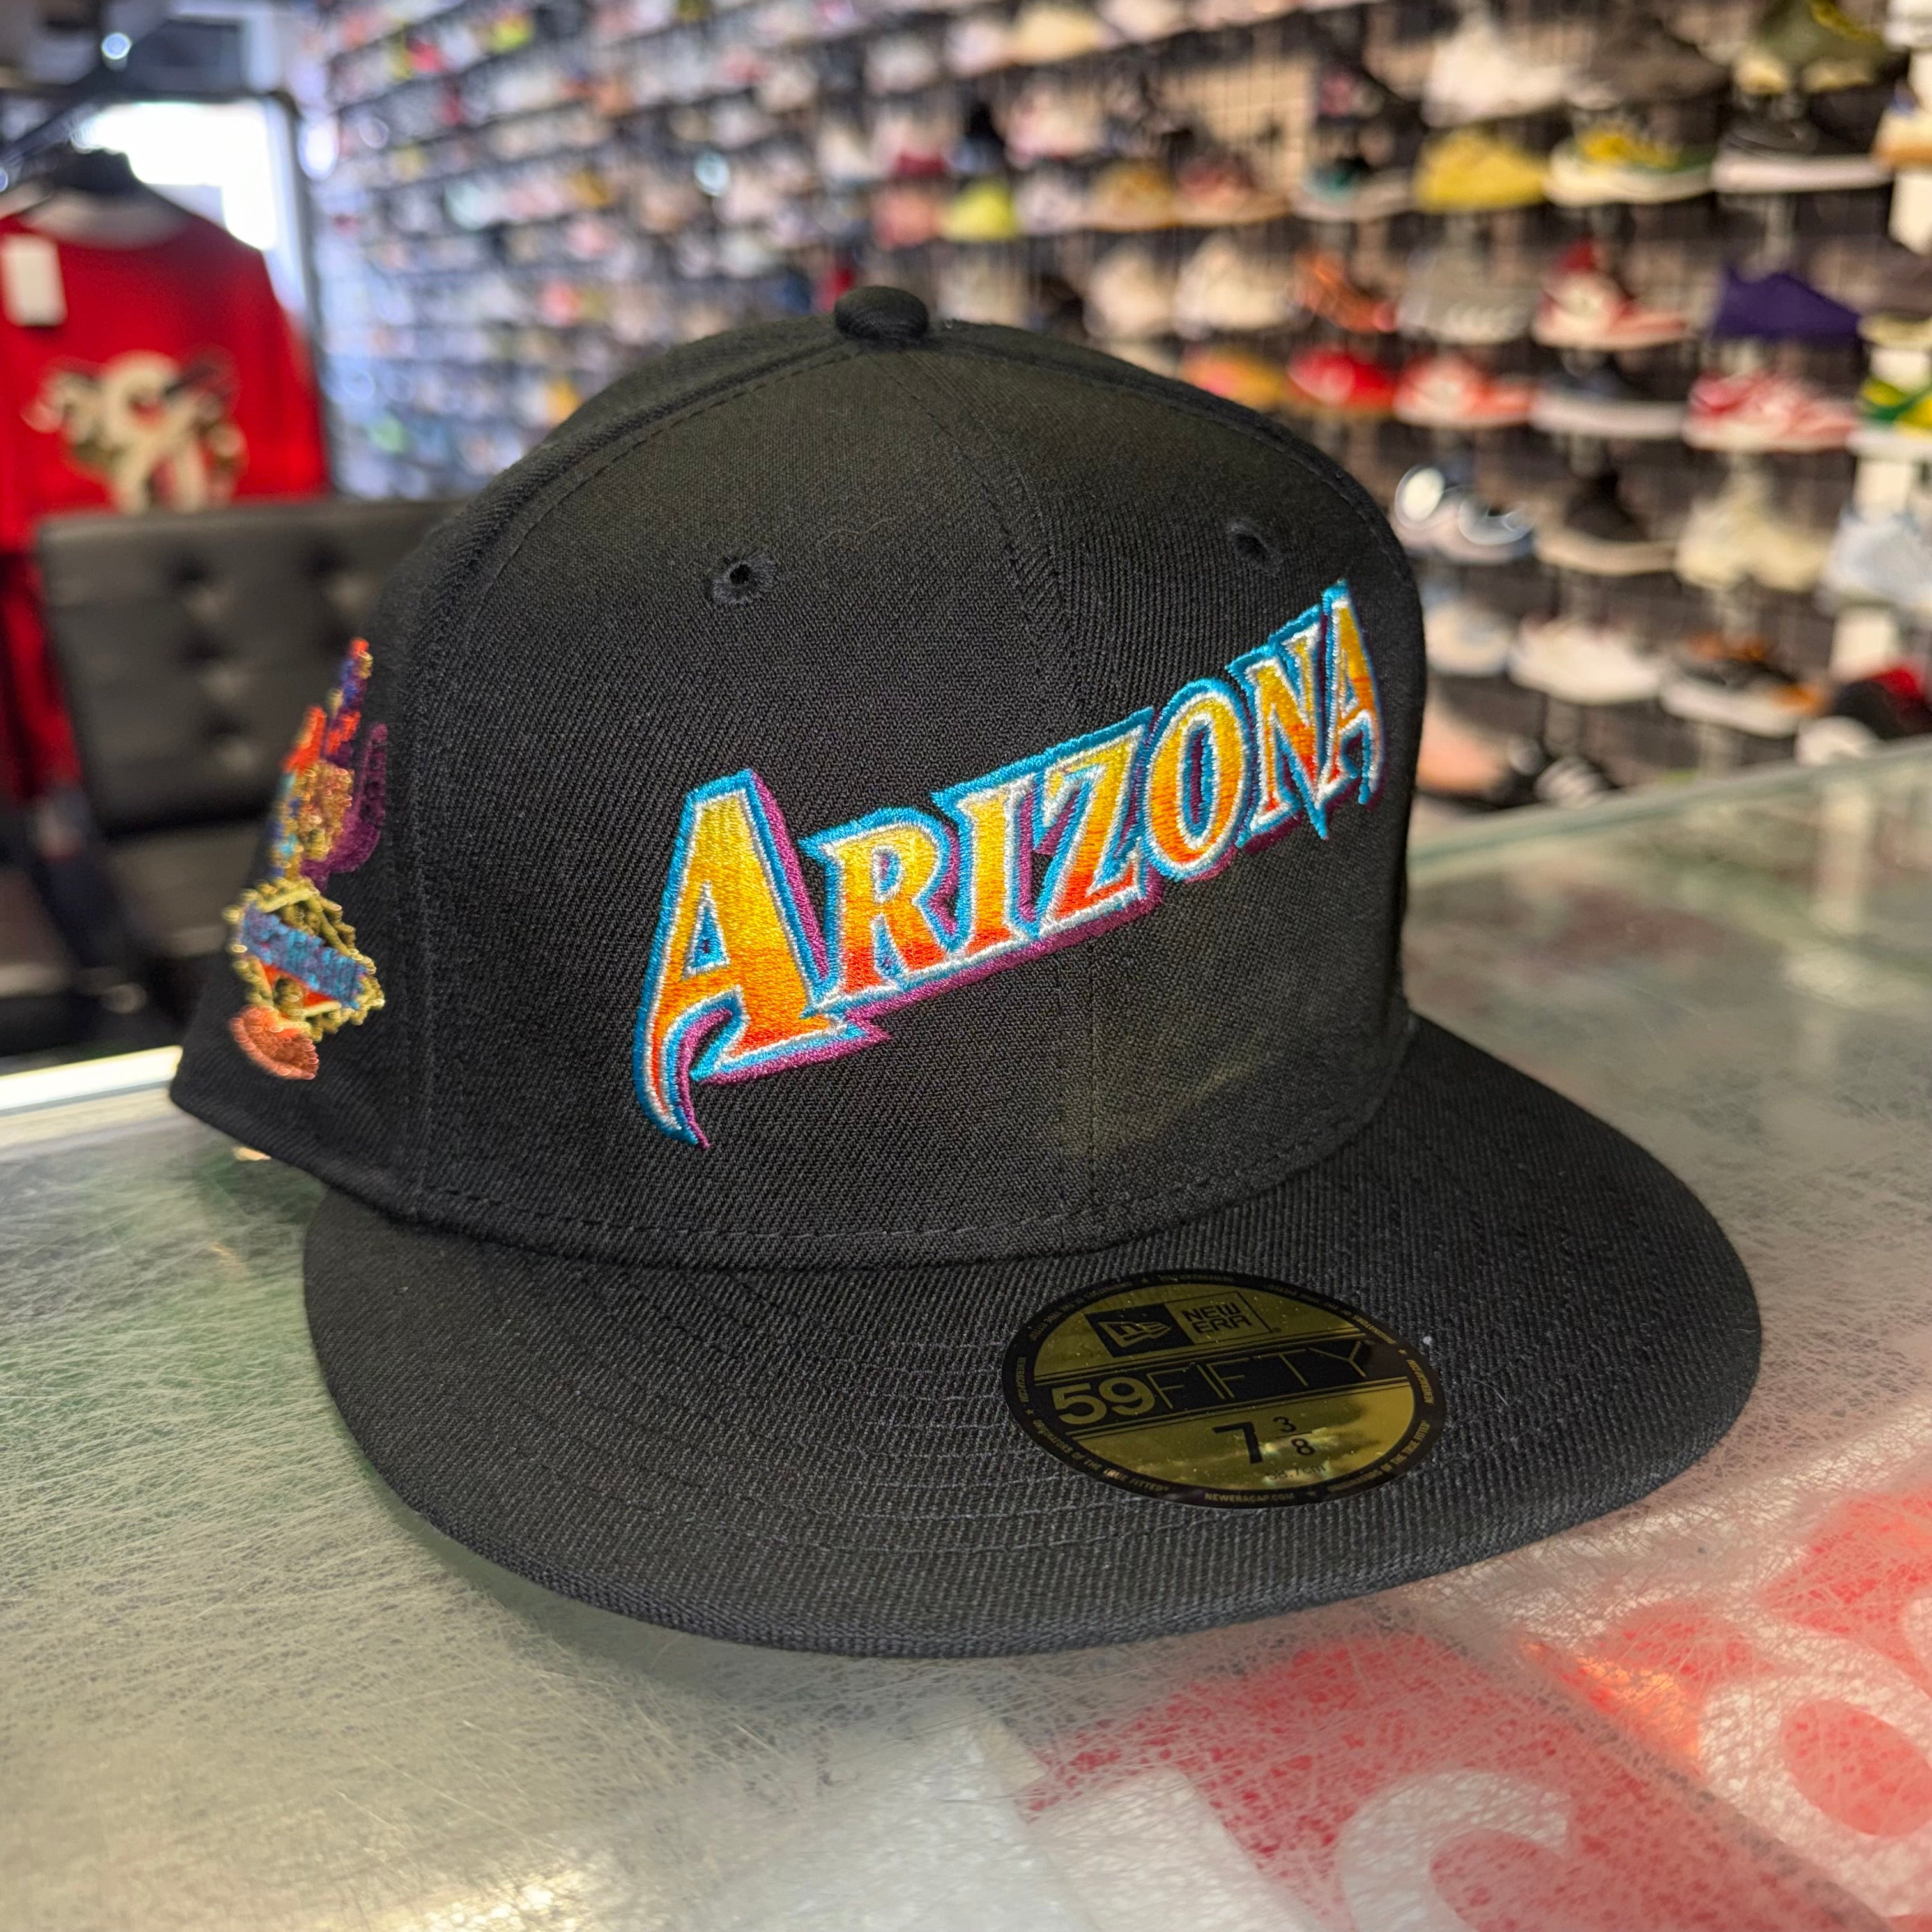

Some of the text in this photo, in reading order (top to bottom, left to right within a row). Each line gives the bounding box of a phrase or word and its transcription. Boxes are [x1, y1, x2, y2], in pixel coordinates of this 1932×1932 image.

[634, 578, 1385, 1147] ARIZONA
[1182, 1302, 1241, 1322] NEW
[1192, 1314, 1253, 1333] ERA
[1051, 1340, 1367, 1425] 59FIFTY
[1032, 1419, 1073, 1454] ORIGINATORS
[1103, 1468, 1128, 1482] TRUE
[1211, 1416, 1315, 1464] 7 3 8
[1204, 1492, 1295, 1503] NEWERACAP.COM
